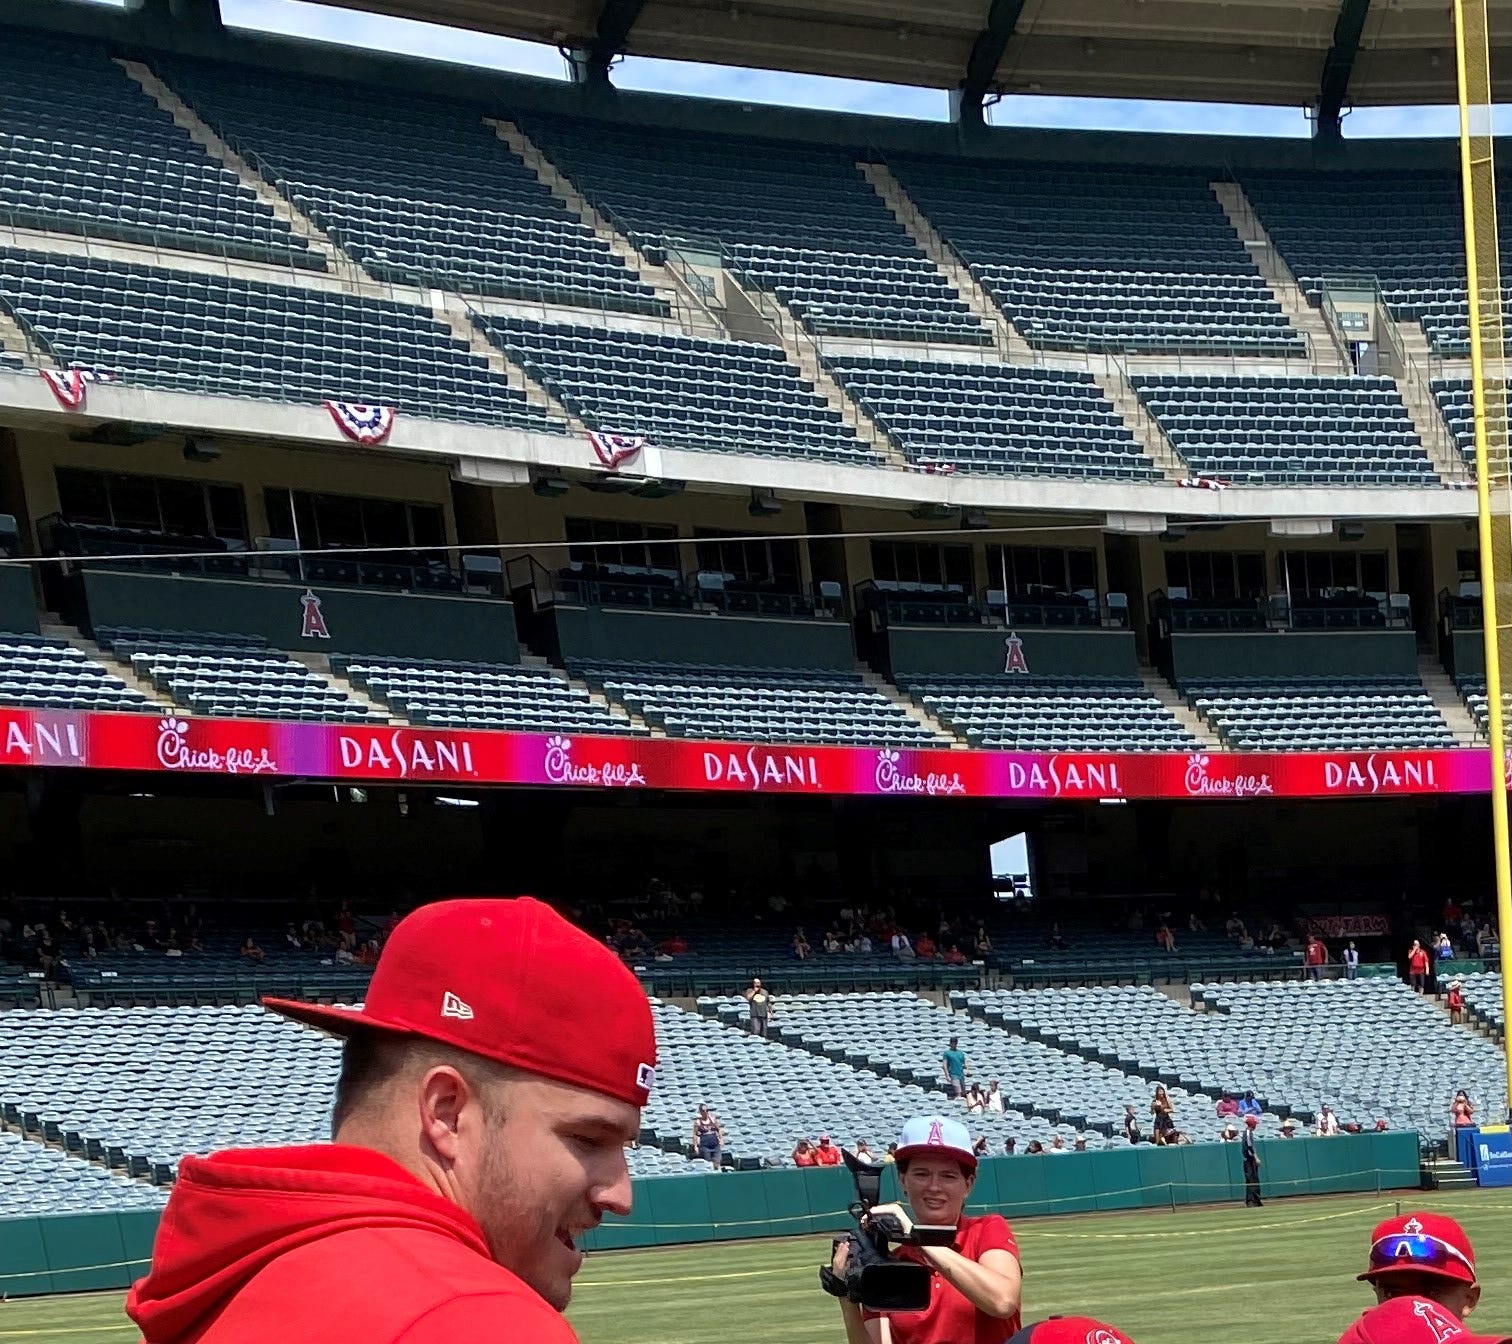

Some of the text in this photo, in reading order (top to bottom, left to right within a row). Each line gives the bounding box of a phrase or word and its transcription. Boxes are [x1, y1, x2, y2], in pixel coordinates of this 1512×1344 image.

[157, 718, 278, 773] Chick-fil-A
[340, 729, 474, 778] DASANI
[545, 736, 646, 786] Chick-fil-A
[703, 745, 817, 790] DASANI
[876, 749, 966, 795] Chick-fil-A
[1008, 755, 1118, 796] DASANI
[1185, 754, 1273, 796] Chick-fil-A
[1324, 753, 1435, 793] DASANI
